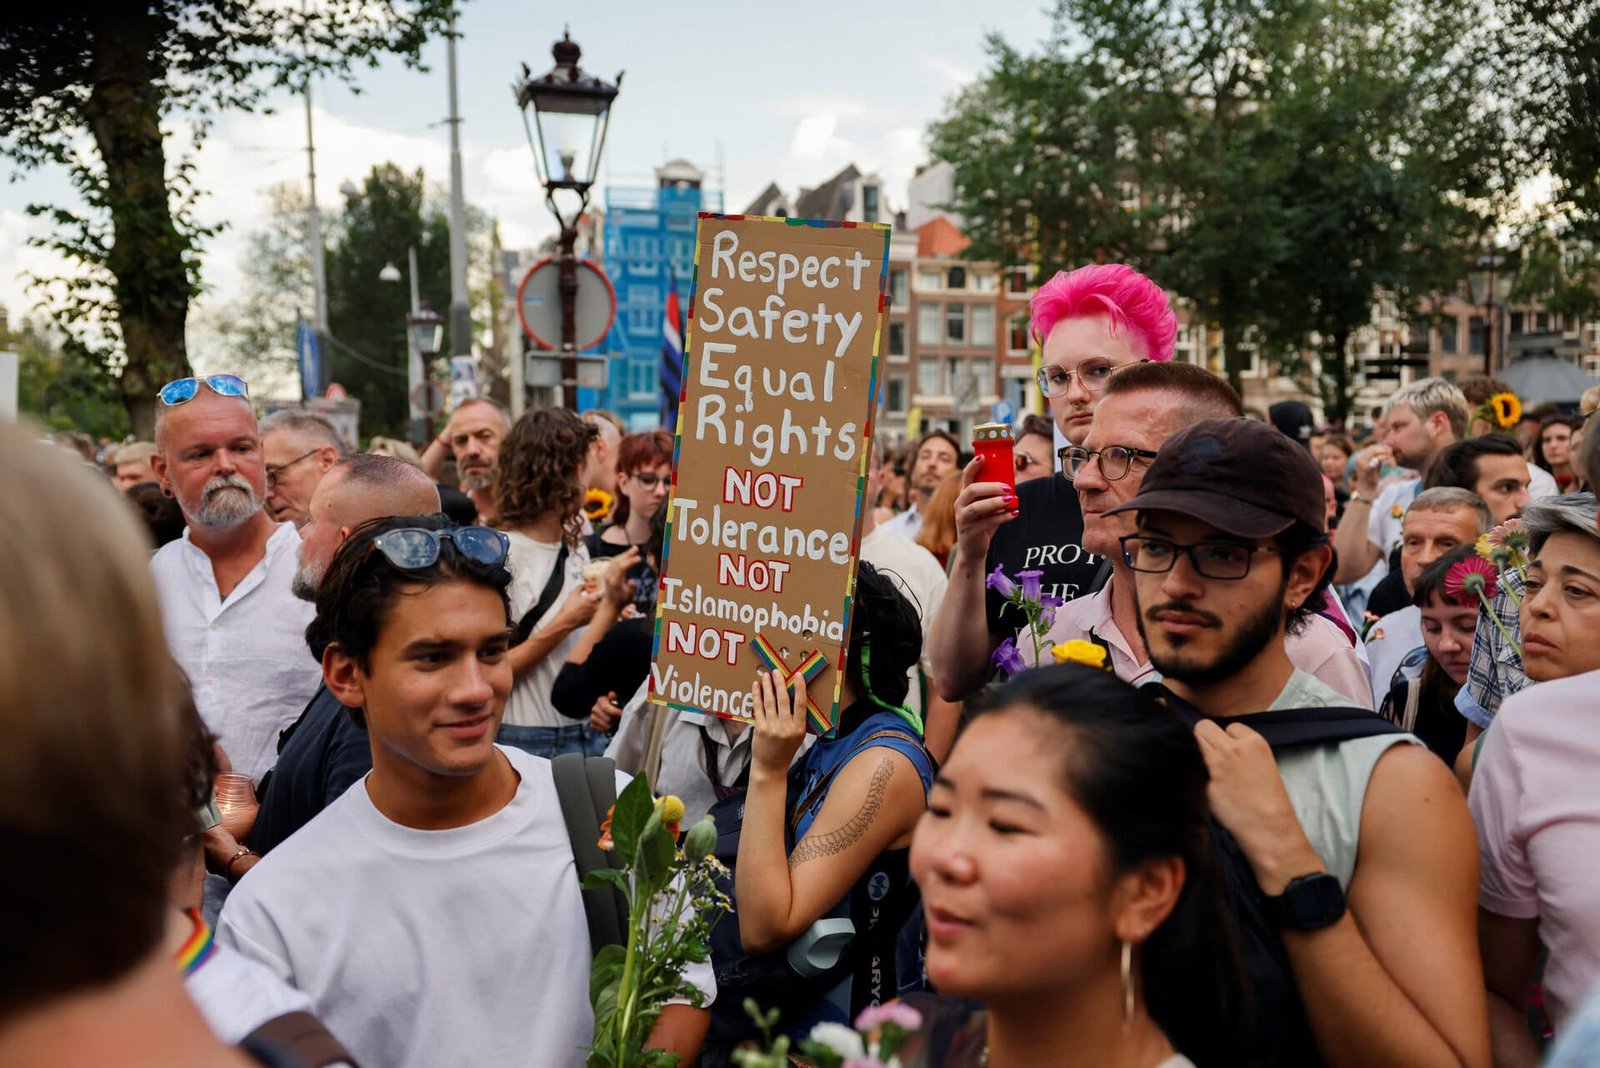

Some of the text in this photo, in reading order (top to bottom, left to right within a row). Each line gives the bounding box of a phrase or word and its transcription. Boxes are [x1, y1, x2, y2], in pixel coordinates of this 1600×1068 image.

[711, 229, 871, 295] Respect
[700, 287, 863, 358] Safety
[700, 341, 835, 413] Equal
[695, 393, 857, 467] Rights
[723, 466, 803, 512] NOT
[673, 497, 850, 565] Tolerance
[718, 552, 791, 593] NOT
[662, 577, 845, 642] Islamophobia
[666, 620, 745, 665] NOT
[651, 661, 754, 718] Violence
